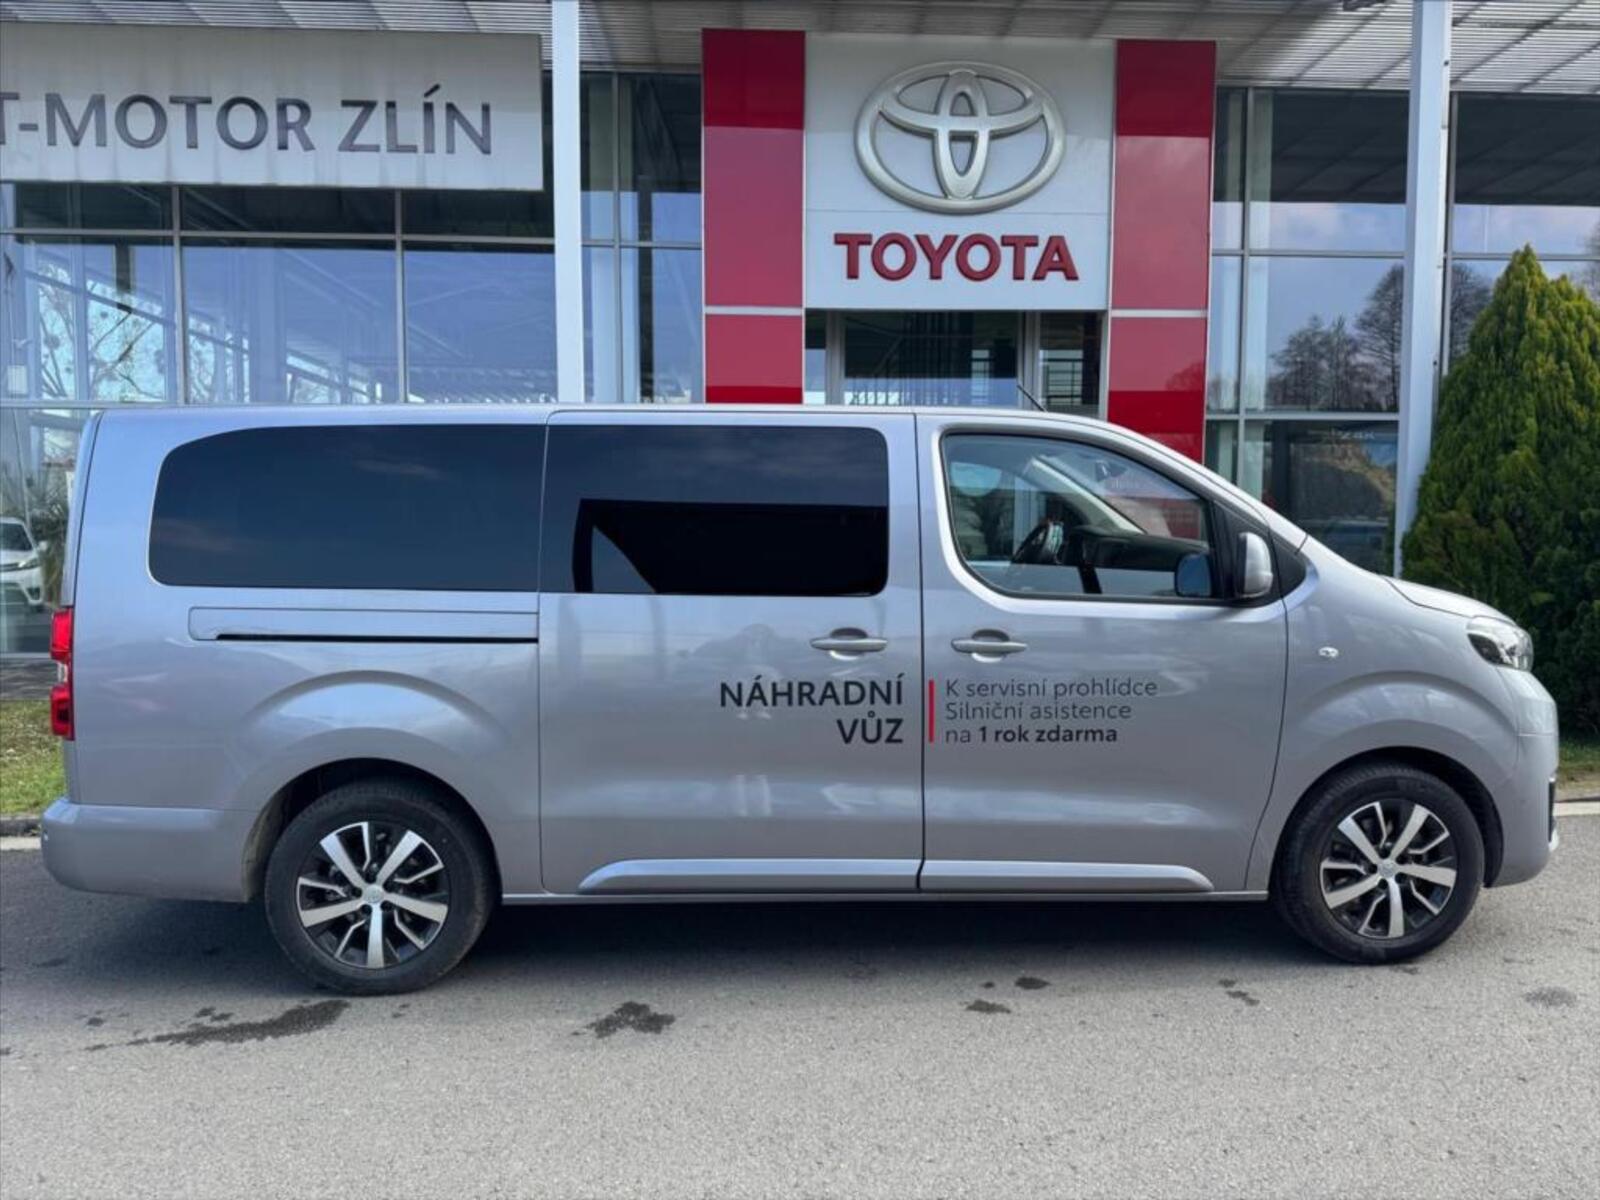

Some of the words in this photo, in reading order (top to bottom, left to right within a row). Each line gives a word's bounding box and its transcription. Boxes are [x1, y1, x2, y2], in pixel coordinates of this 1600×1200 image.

[338, 84, 492, 155] ZLÍN
[834, 233, 1079, 281] TOYOTA
[720, 673, 904, 707] NÁHRADNÍ
[946, 679, 959, 697] K
[966, 678, 1048, 698] servisní
[1054, 678, 1158, 700] prohlídce
[837, 710, 904, 744] VŮZ
[946, 701, 1023, 720] Silniční
[1030, 702, 1132, 720] asistence
[945, 729, 971, 743] na
[979, 726, 987, 743] 1
[994, 725, 1029, 743] rok
[1036, 725, 1118, 743] zdarma
